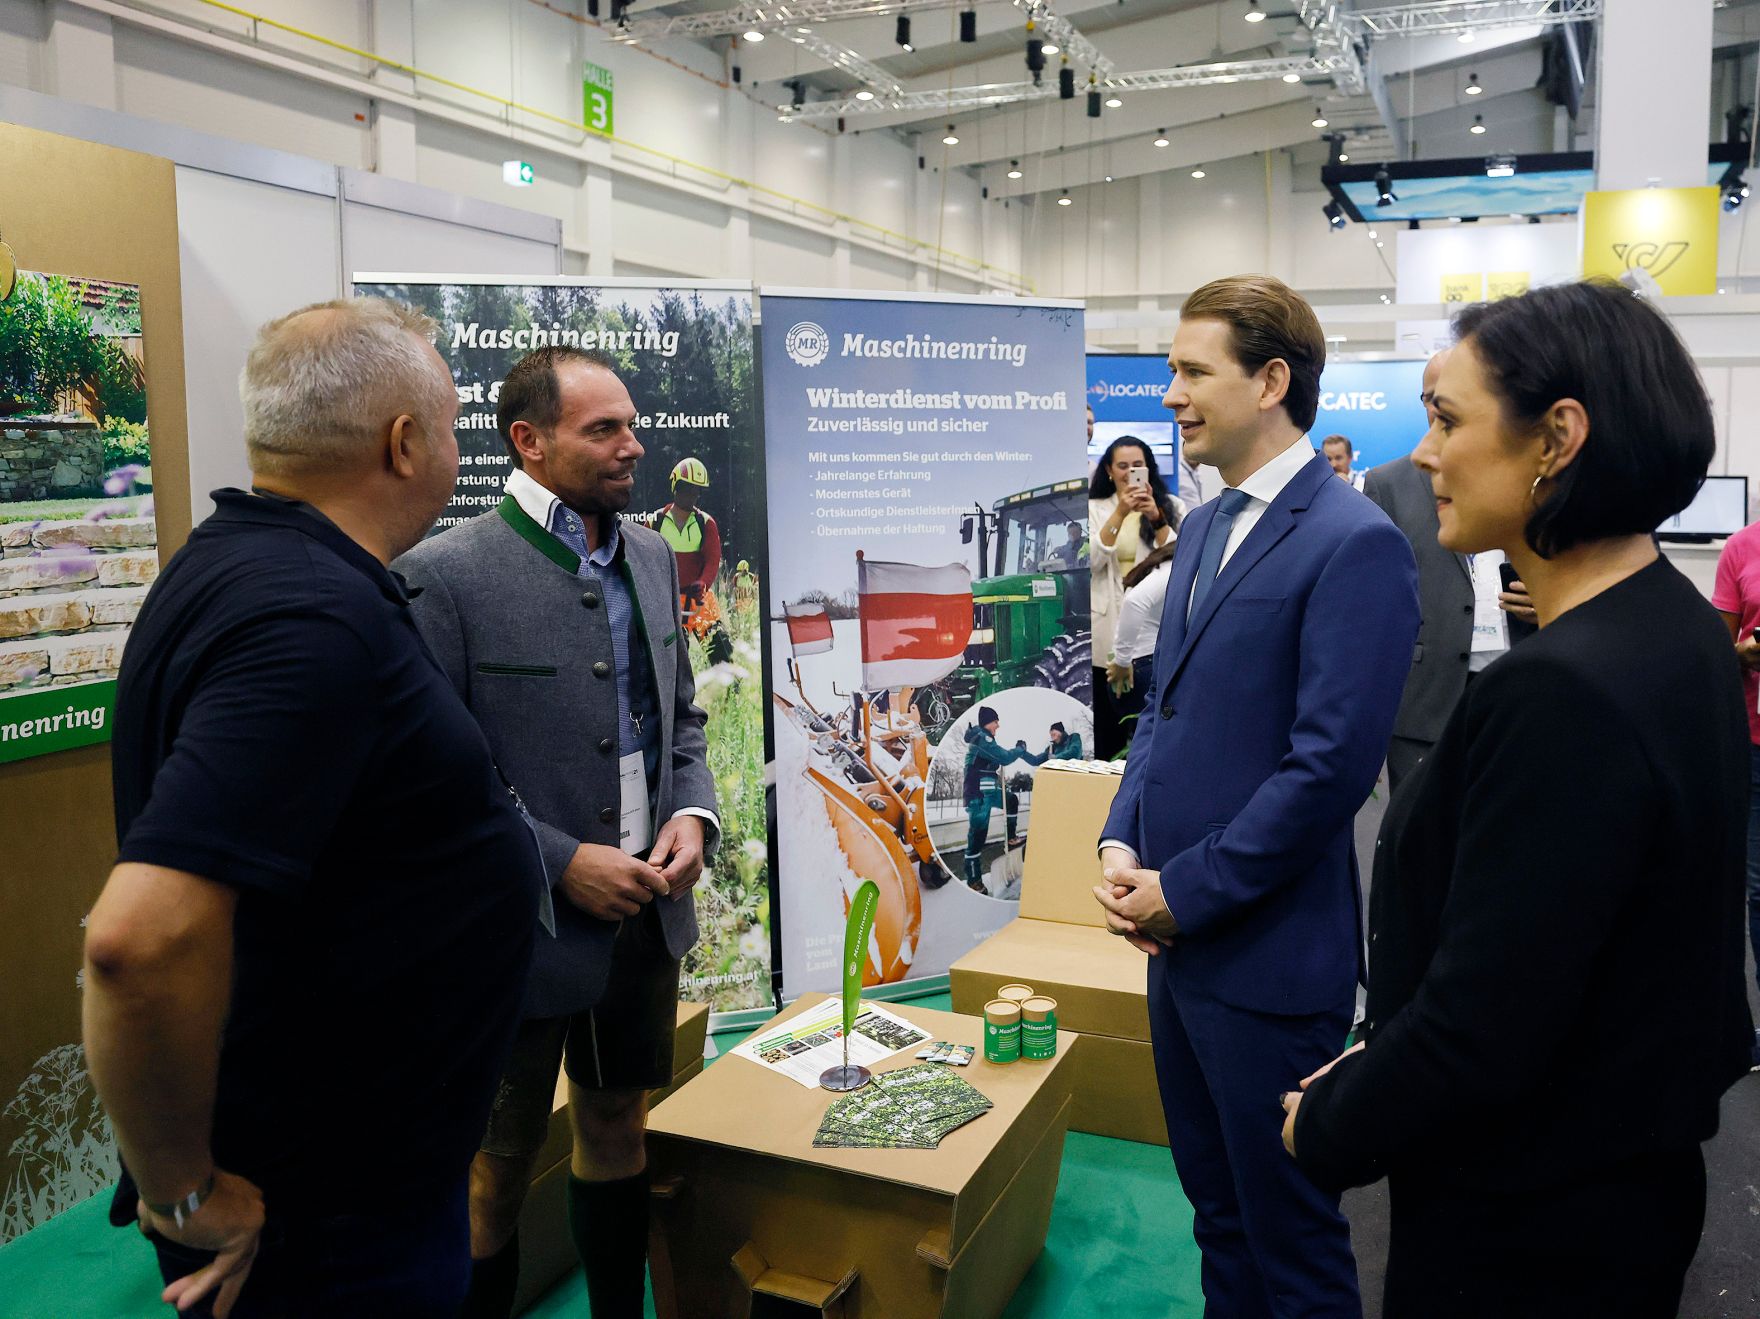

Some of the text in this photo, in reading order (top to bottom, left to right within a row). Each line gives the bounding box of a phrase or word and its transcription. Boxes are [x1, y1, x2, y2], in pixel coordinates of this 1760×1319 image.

[591, 92, 607, 129] 3
[451, 322, 680, 356] Maschinenring
[797, 337, 818, 350] MR
[840, 333, 1027, 367] Maschinenring
[454, 382, 485, 404] st
[1109, 384, 1168, 397] LOCATEC
[806, 387, 1068, 411] Winterdienst vom Profi
[1317, 391, 1387, 411] CATEC
[655, 412, 730, 429] Zukunft
[807, 416, 989, 435] Zuverlässig und sicher
[458, 453, 510, 466] us einer
[808, 451, 1033, 464] Mit uns kommen Sie gut durch den Winter:
[456, 474, 500, 488] rstung
[815, 470, 876, 483] Jahrelange
[877, 470, 931, 481] Erfahrung
[815, 488, 881, 500] Modernstes
[882, 487, 912, 498] Gerät
[816, 507, 885, 518] Ortskundige
[817, 524, 881, 536] Übernahme
[884, 524, 901, 534] der
[902, 523, 946, 535] Haftung
[0, 705, 106, 742] nenring
